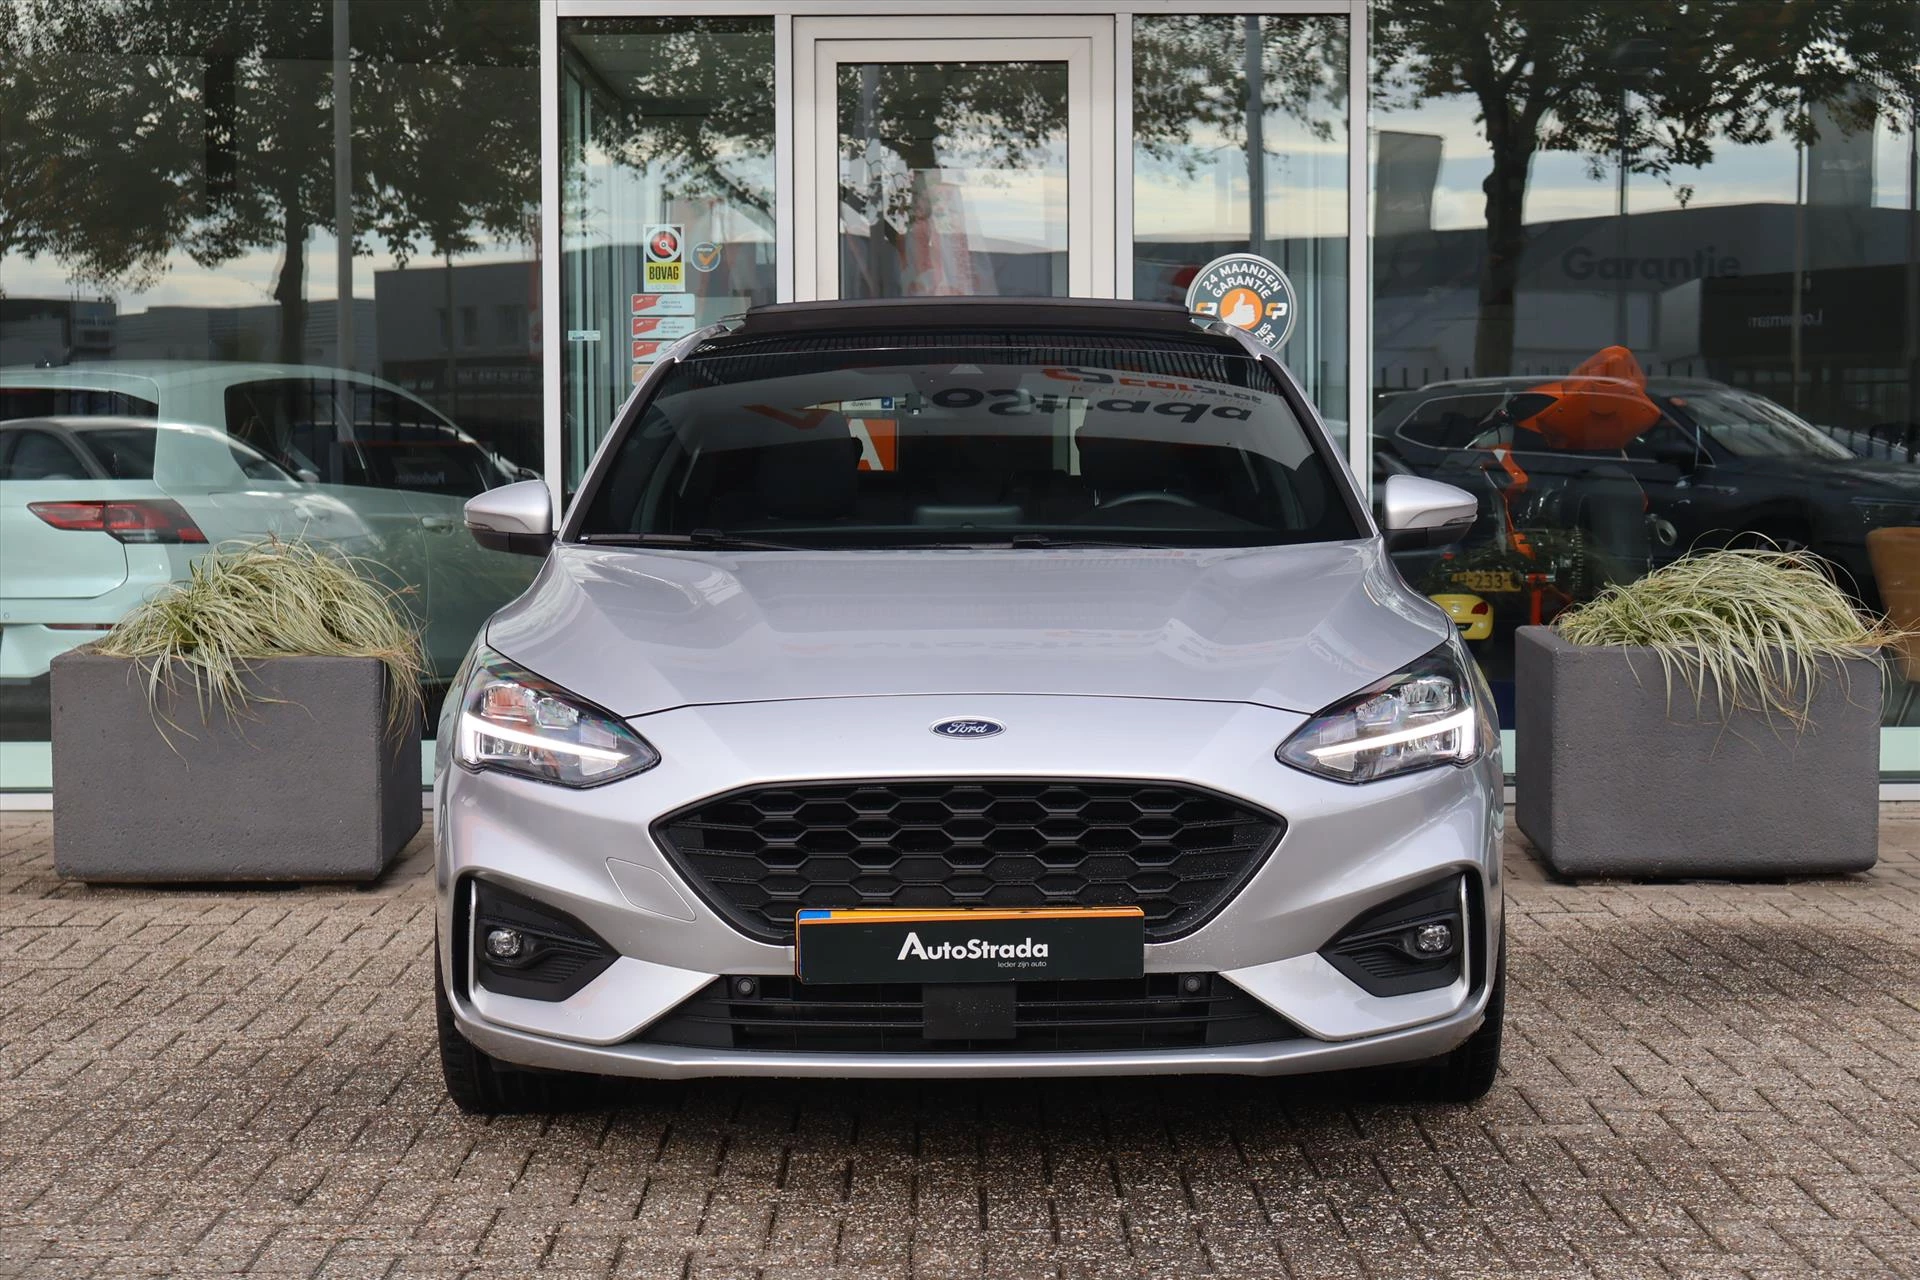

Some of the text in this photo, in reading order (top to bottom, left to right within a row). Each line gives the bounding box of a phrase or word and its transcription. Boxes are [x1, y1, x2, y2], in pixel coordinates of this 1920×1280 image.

[648, 265, 679, 281] BOVAG
[1561, 245, 1741, 280] Garantie
[1202, 263, 1282, 292] 24 MAANDEN
[1212, 275, 1272, 299] GARANTIE
[947, 721, 988, 733] Ford
[897, 931, 1049, 961] AutoStrada
